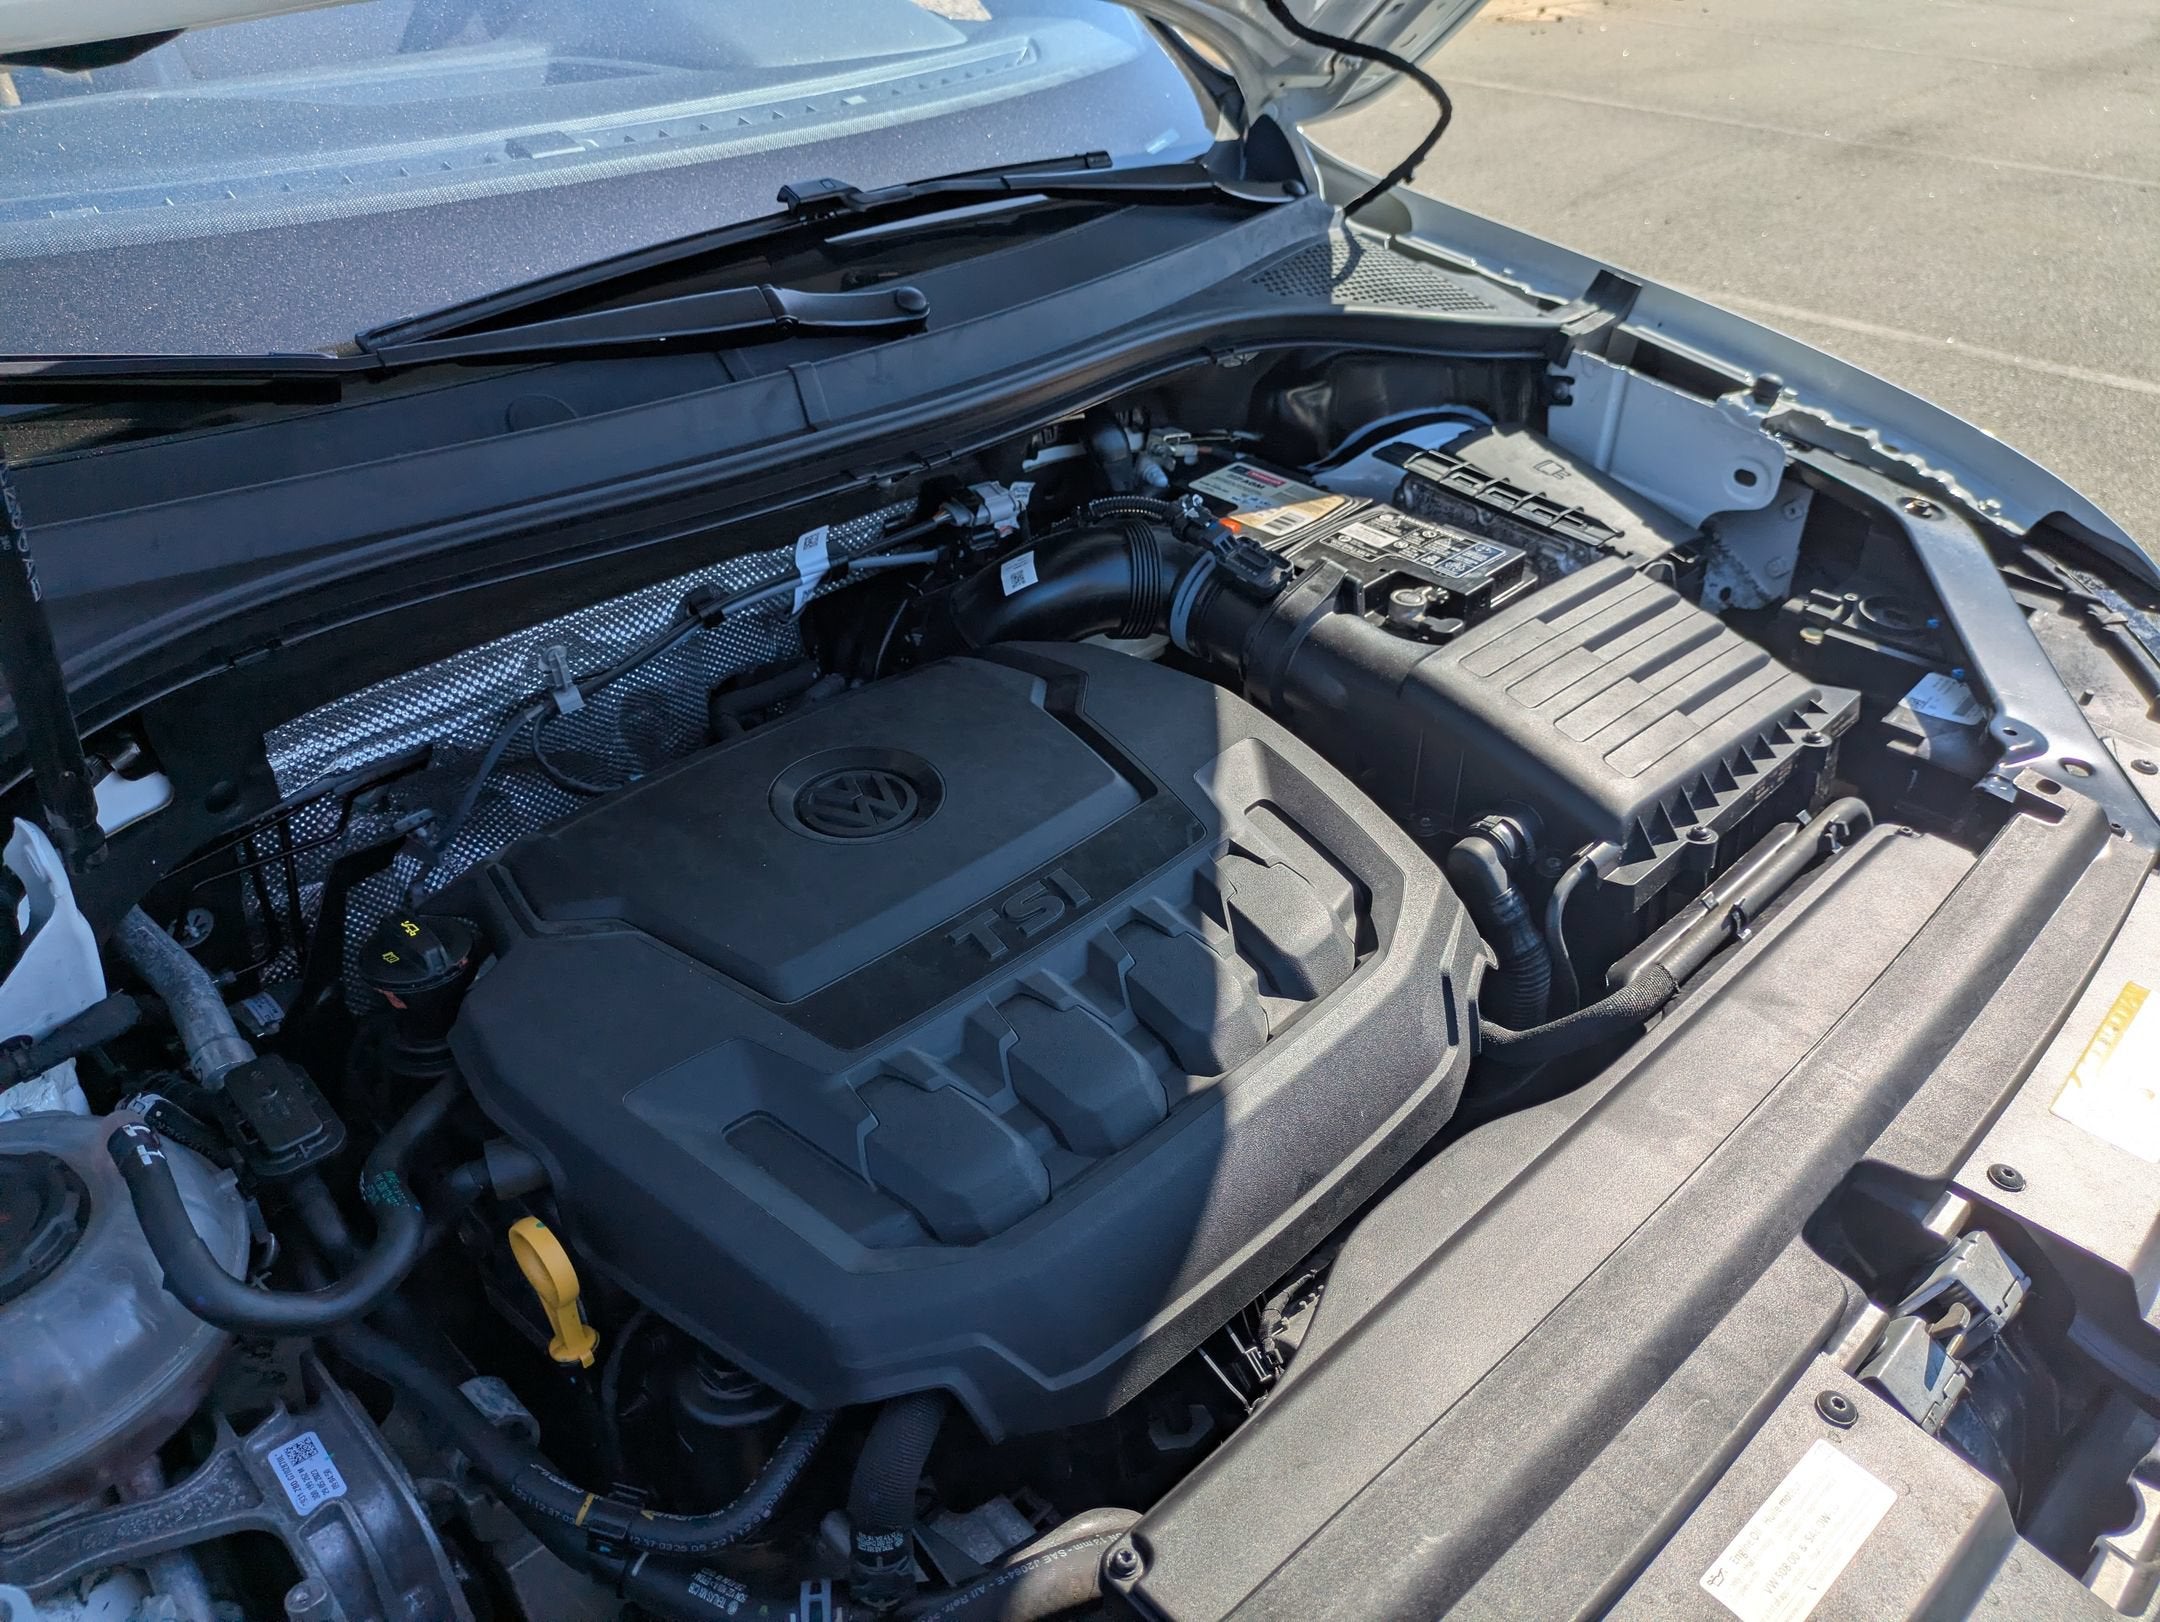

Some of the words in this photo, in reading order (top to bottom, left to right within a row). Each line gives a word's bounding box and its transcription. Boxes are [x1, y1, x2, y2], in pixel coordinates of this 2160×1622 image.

[945, 868, 1091, 961] TSI
[1043, 1549, 1067, 1564] SAE
[971, 1585, 985, 1597] All
[1764, 1578, 1779, 1593] VW
